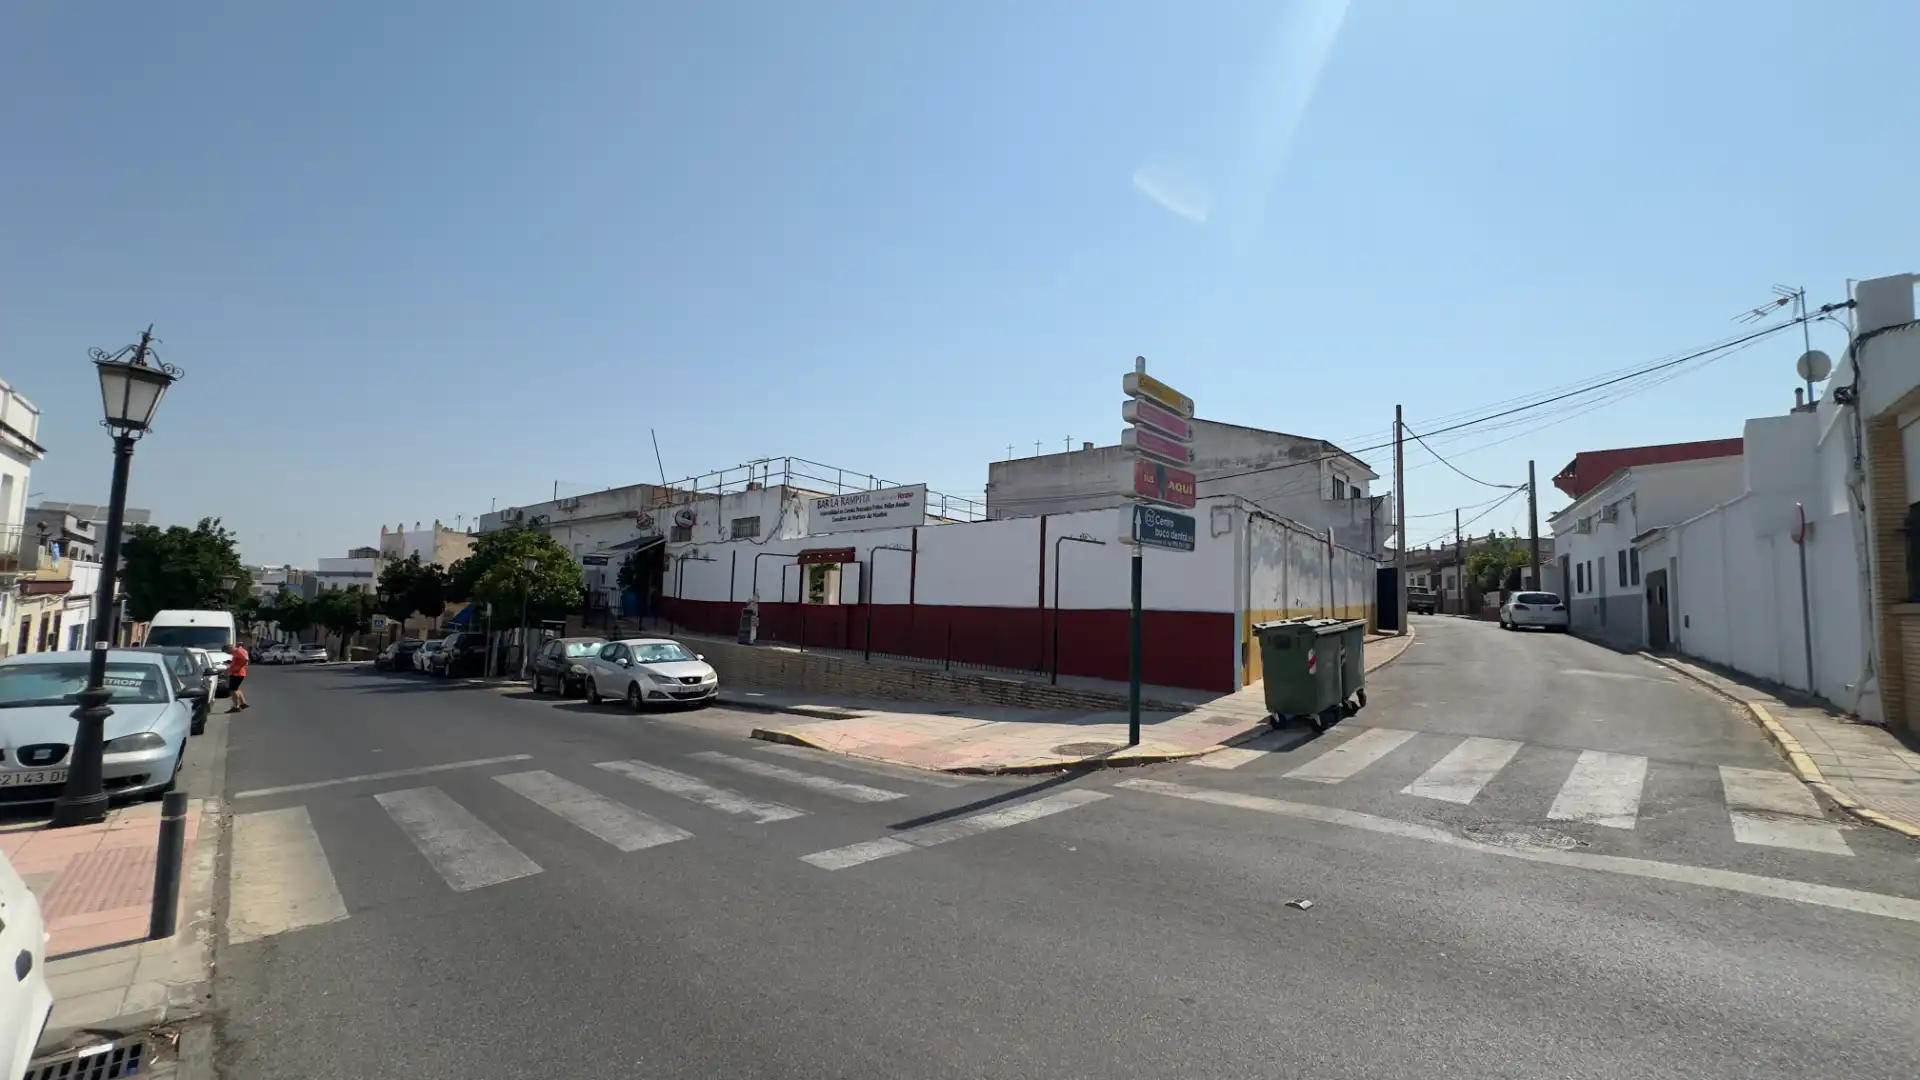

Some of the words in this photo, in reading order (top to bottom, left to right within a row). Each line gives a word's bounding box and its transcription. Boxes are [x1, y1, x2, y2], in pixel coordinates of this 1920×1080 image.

[817, 500, 829, 509] BAR
[830, 498, 839, 508] LA
[841, 494, 871, 506] RAMPITA
[104, 678, 142, 687] TROPR
[2, 772, 44, 786] 2143
